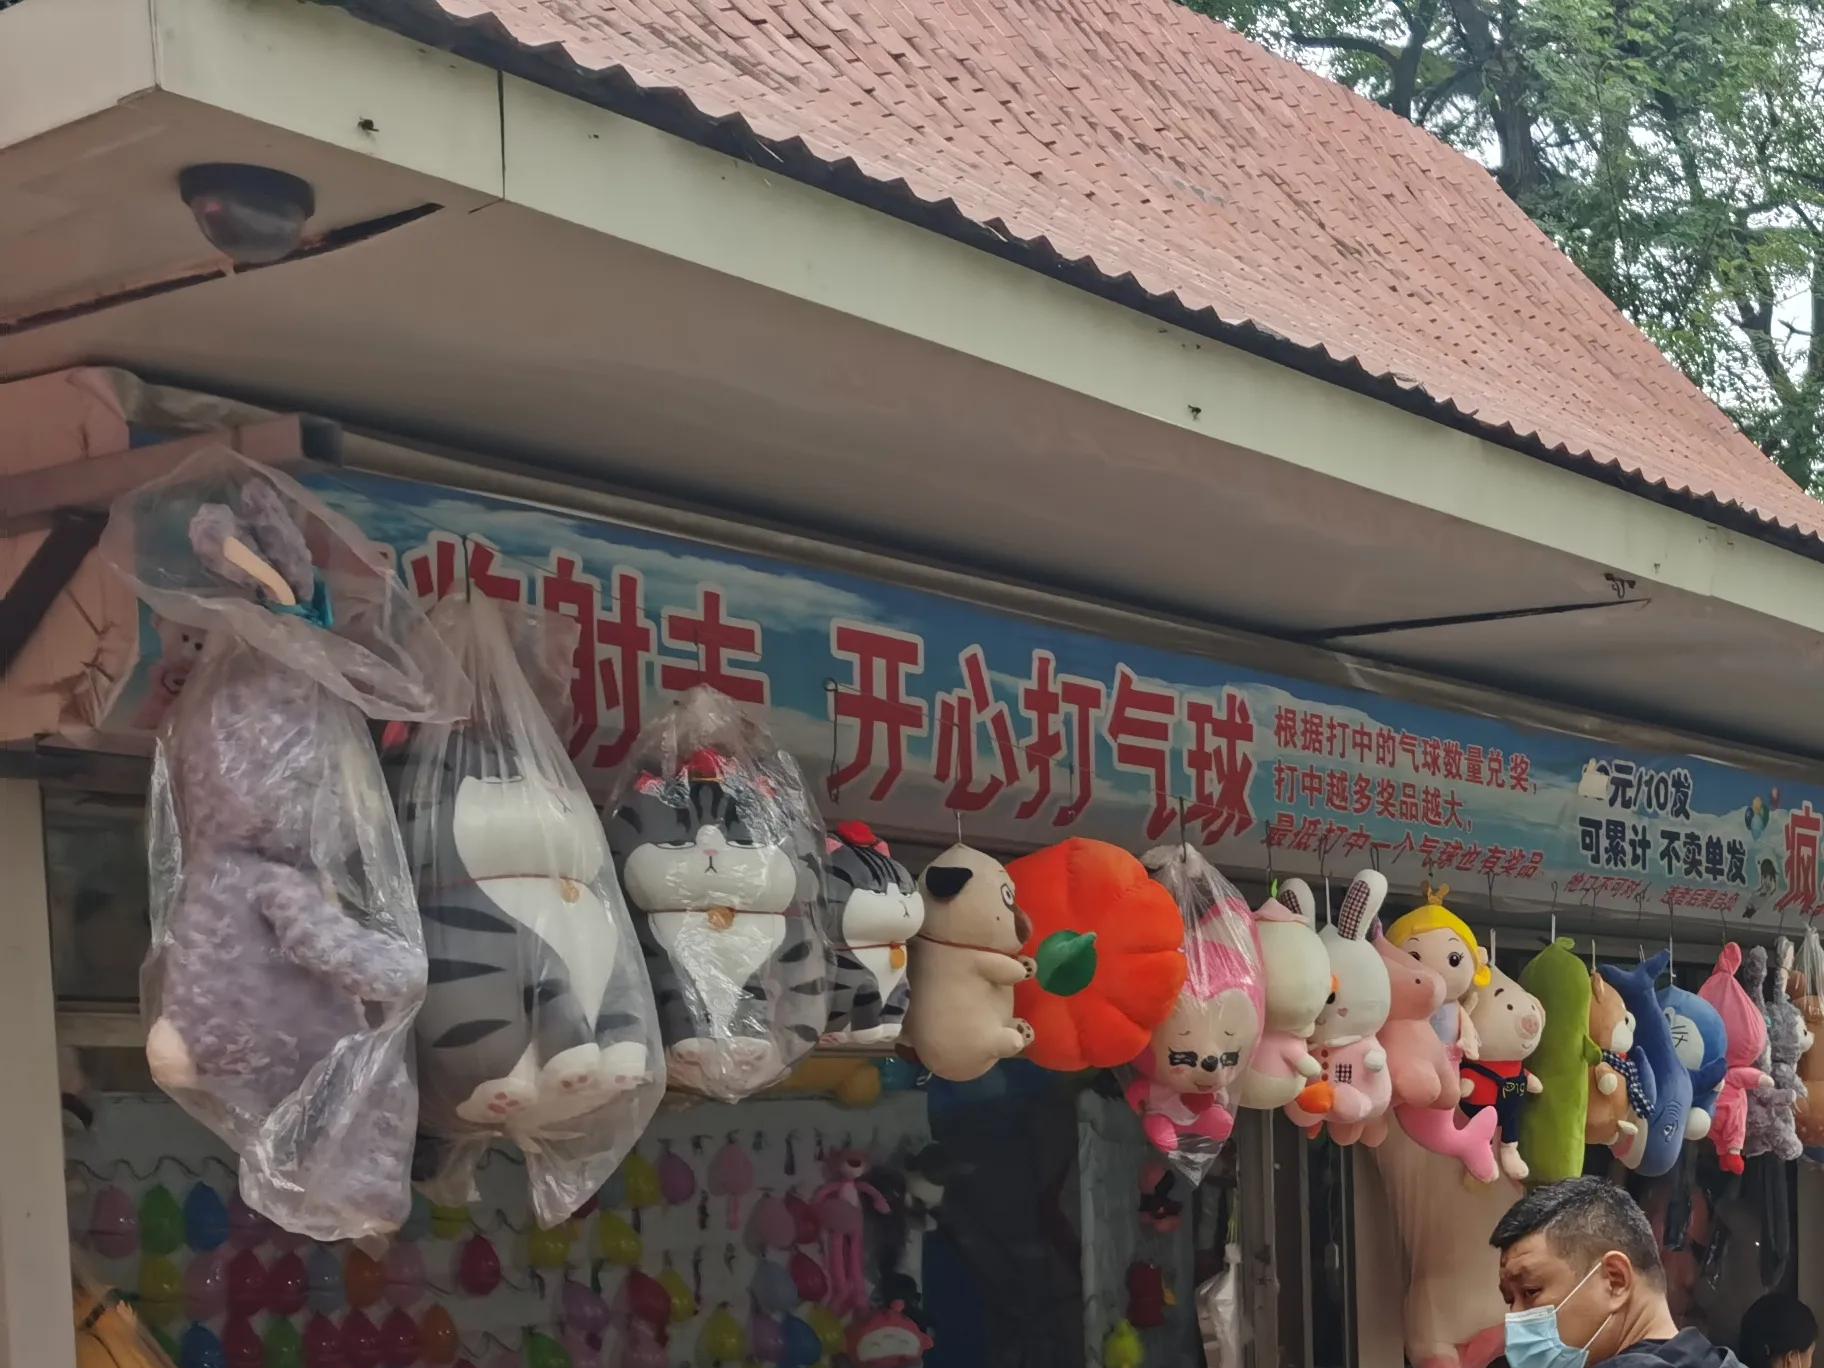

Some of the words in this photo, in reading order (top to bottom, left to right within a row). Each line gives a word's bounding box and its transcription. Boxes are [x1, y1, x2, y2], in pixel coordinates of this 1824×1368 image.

[833, 624, 1257, 842] 开心打气球
[1578, 816, 1651, 872] 可累计
[1659, 828, 1747, 885] 不卖单发
[1502, 1081, 1526, 1099] Pig
